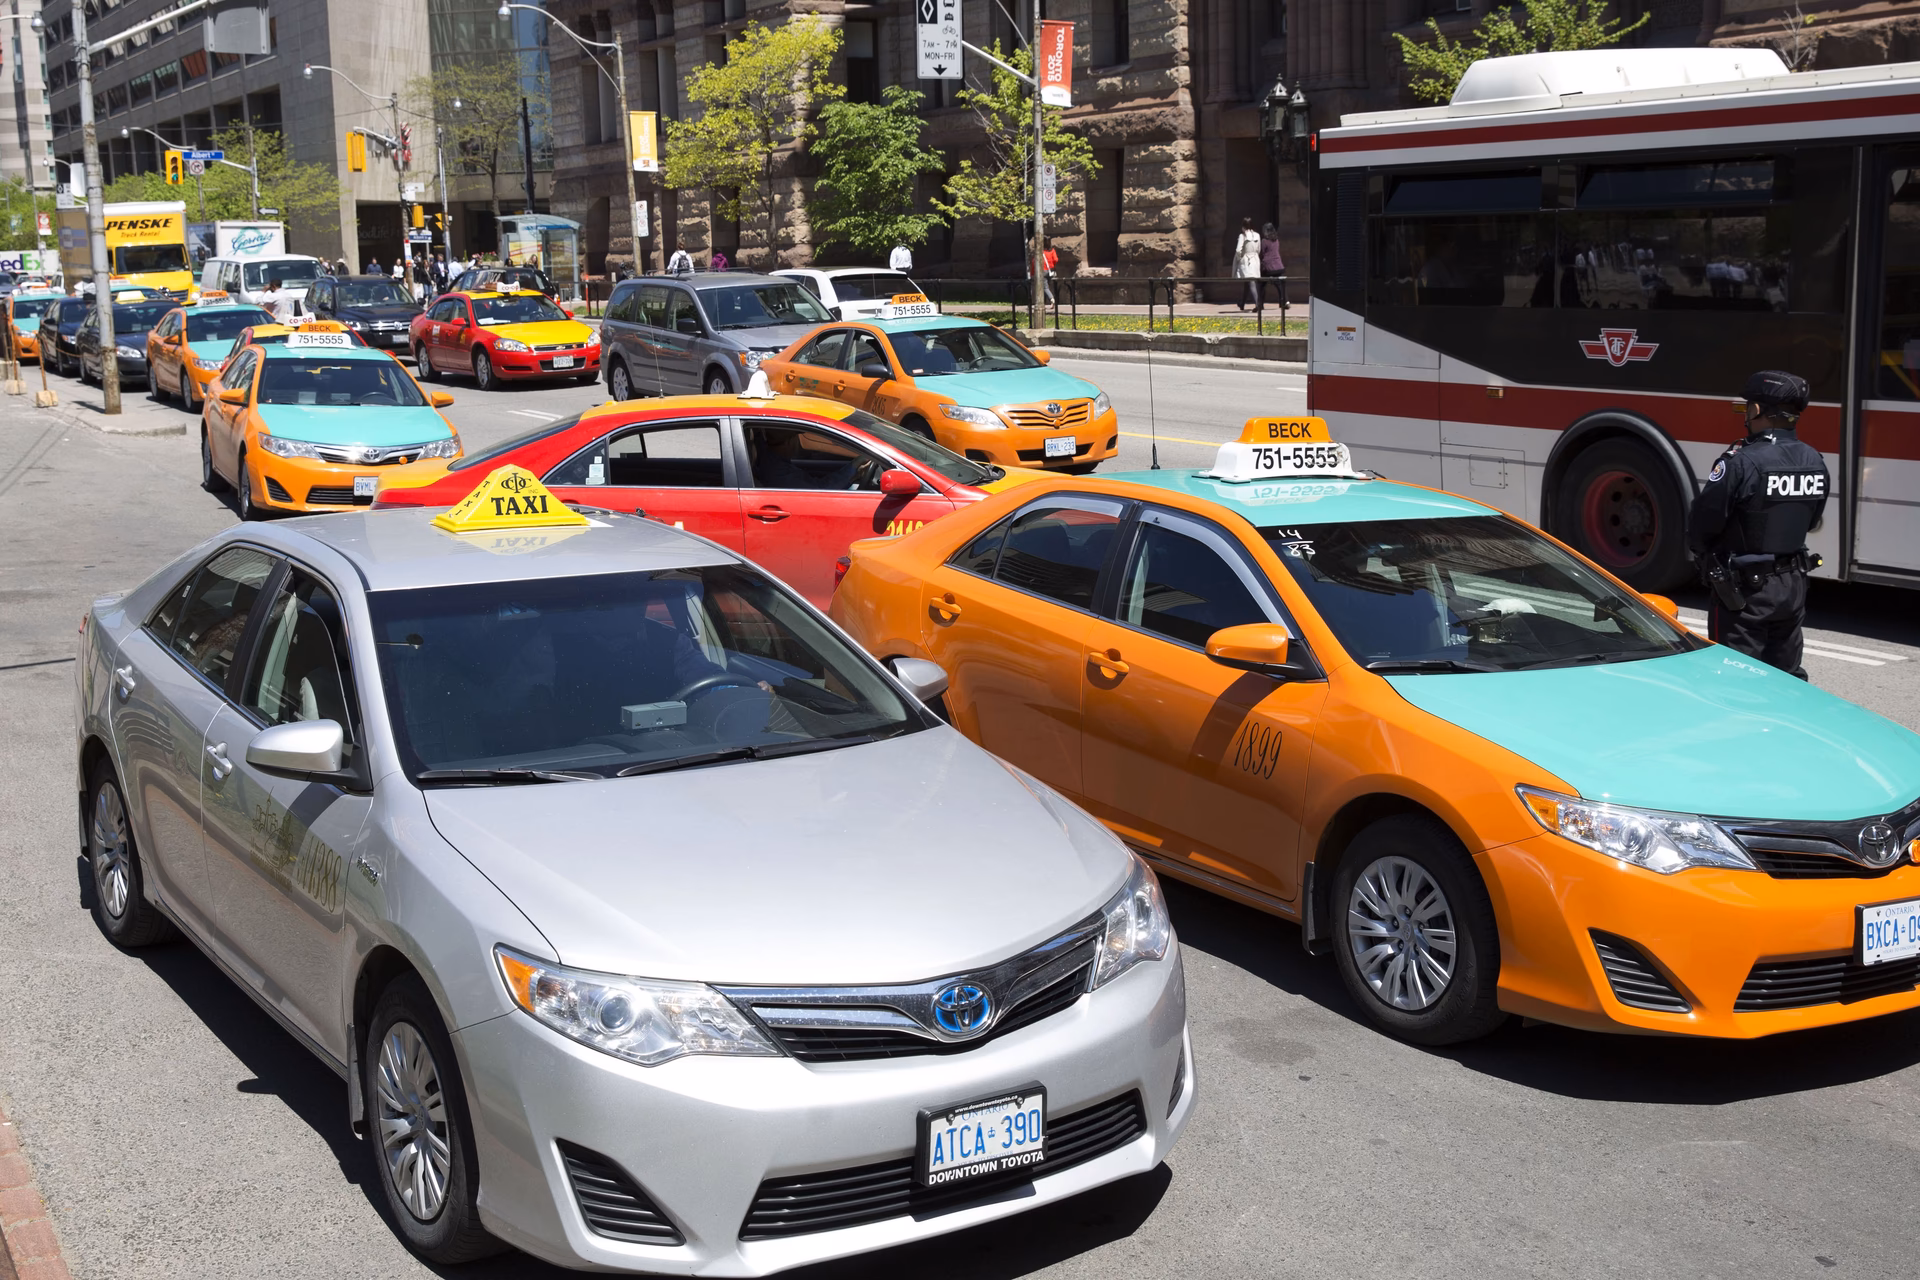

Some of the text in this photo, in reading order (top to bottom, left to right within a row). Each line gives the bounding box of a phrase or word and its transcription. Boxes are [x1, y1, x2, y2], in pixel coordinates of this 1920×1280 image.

[924, 52, 956, 60] MON-FRI
[1054, 27, 1065, 83] TORONTO
[1047, 54, 1056, 82] 2015
[105, 217, 173, 231] PENSKE
[0, 253, 46, 271] edEx
[898, 295, 923, 303] BECK
[893, 304, 931, 316] 751-5555
[298, 334, 344, 344] 751-5555
[1268, 422, 1312, 438] BECK
[1063, 441, 1075, 451] 233
[1252, 446, 1339, 470] 751-5555
[1766, 474, 1824, 496] POLICE
[490, 495, 549, 516] TAXI
[1287, 543, 1316, 557] 83
[1234, 719, 1283, 780] 1899
[1885, 905, 1915, 918] ONTARIO
[1866, 918, 1900, 951] BXCA
[954, 1095, 1018, 1114] www.downtowntoyota.ca
[961, 1102, 1010, 1121] ONTARIO
[932, 1108, 1041, 1166] ATCA 390
[928, 1150, 1044, 1185] DOWNTOWN TOYOTA
